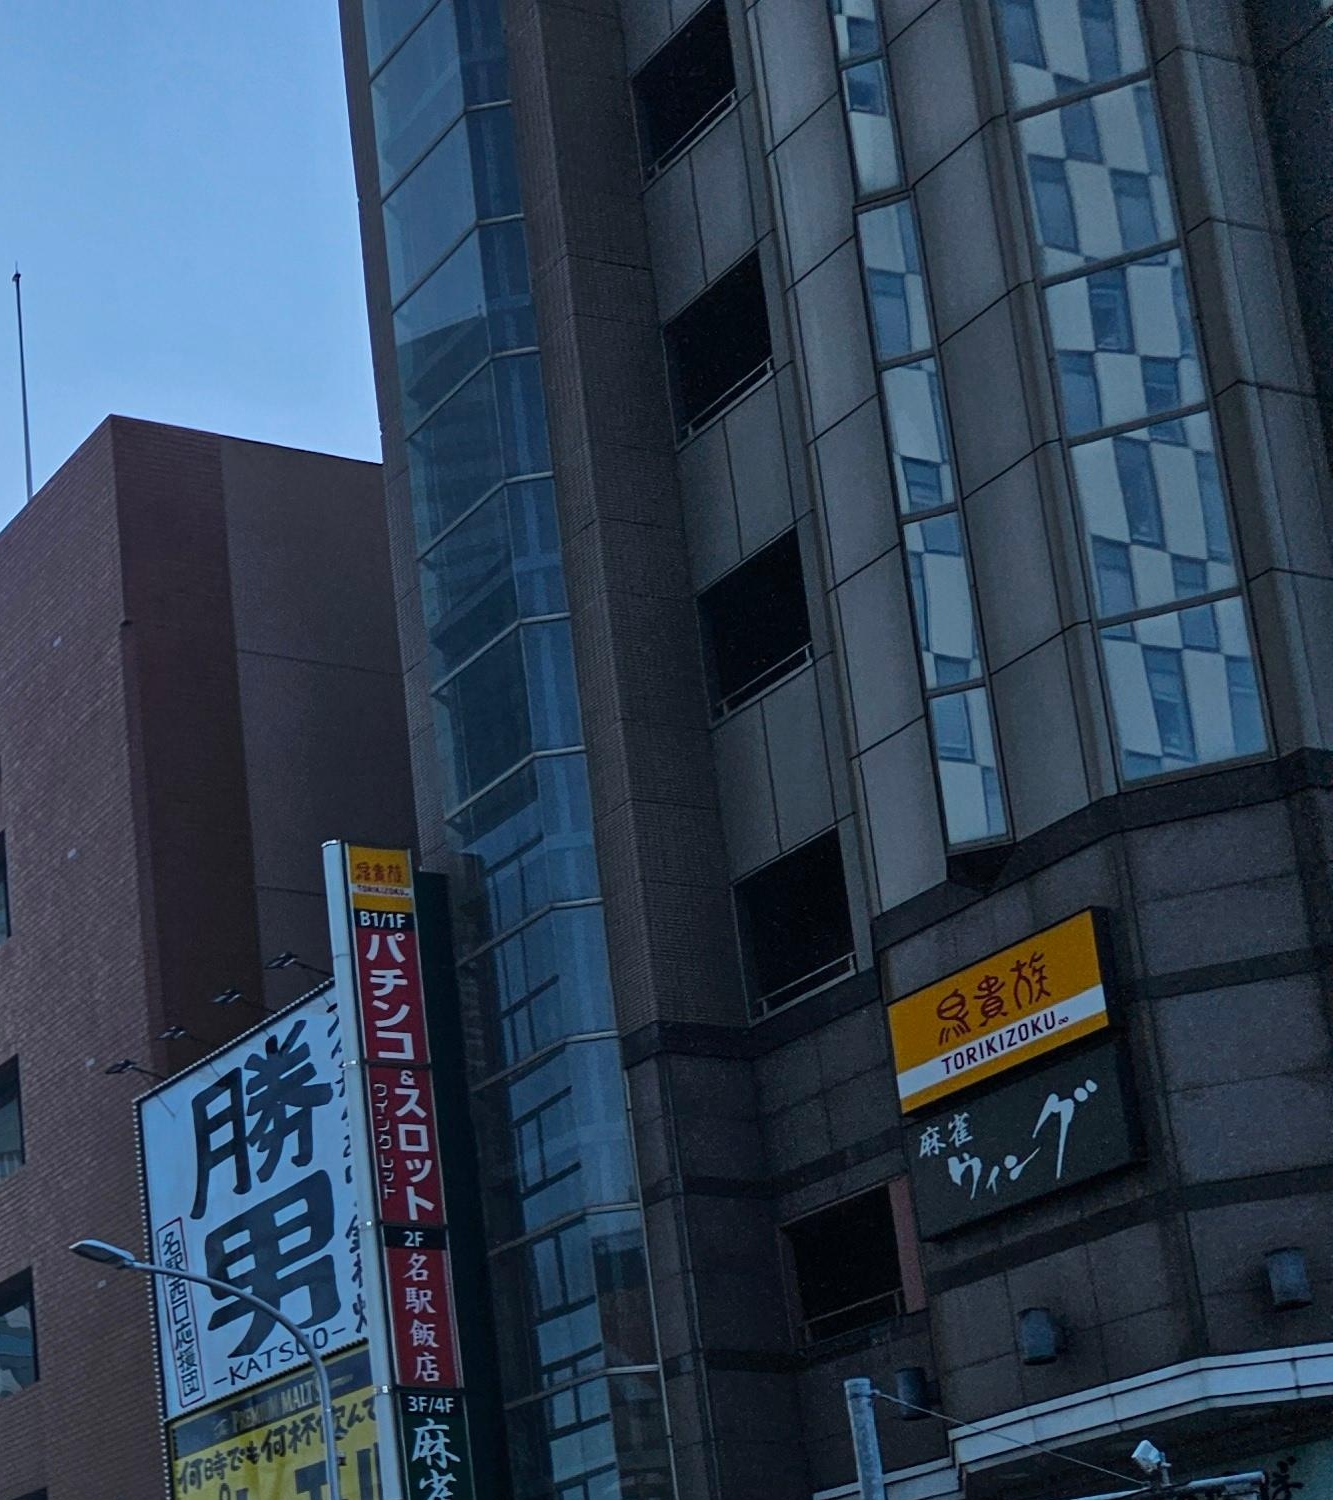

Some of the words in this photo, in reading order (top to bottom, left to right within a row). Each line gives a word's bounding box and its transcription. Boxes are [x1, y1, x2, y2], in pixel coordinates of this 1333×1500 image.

[359, 910, 406, 928] B1/1F
[366, 933, 415, 1060] パチンコ
[937, 952, 1050, 1045] 鳥貴族
[941, 1011, 1055, 1075] TORIKIZOKU
[918, 1112, 973, 1158] 麻雀
[947, 1079, 1098, 1200] ウィング
[190, 1019, 341, 1358] 勝男
[403, 1231, 425, 1247] 2F
[162, 1230, 201, 1396] 名駅西口応援団
[402, 1253, 440, 1383] 名駅飯店
[407, 1396, 454, 1413] 3F/4F
